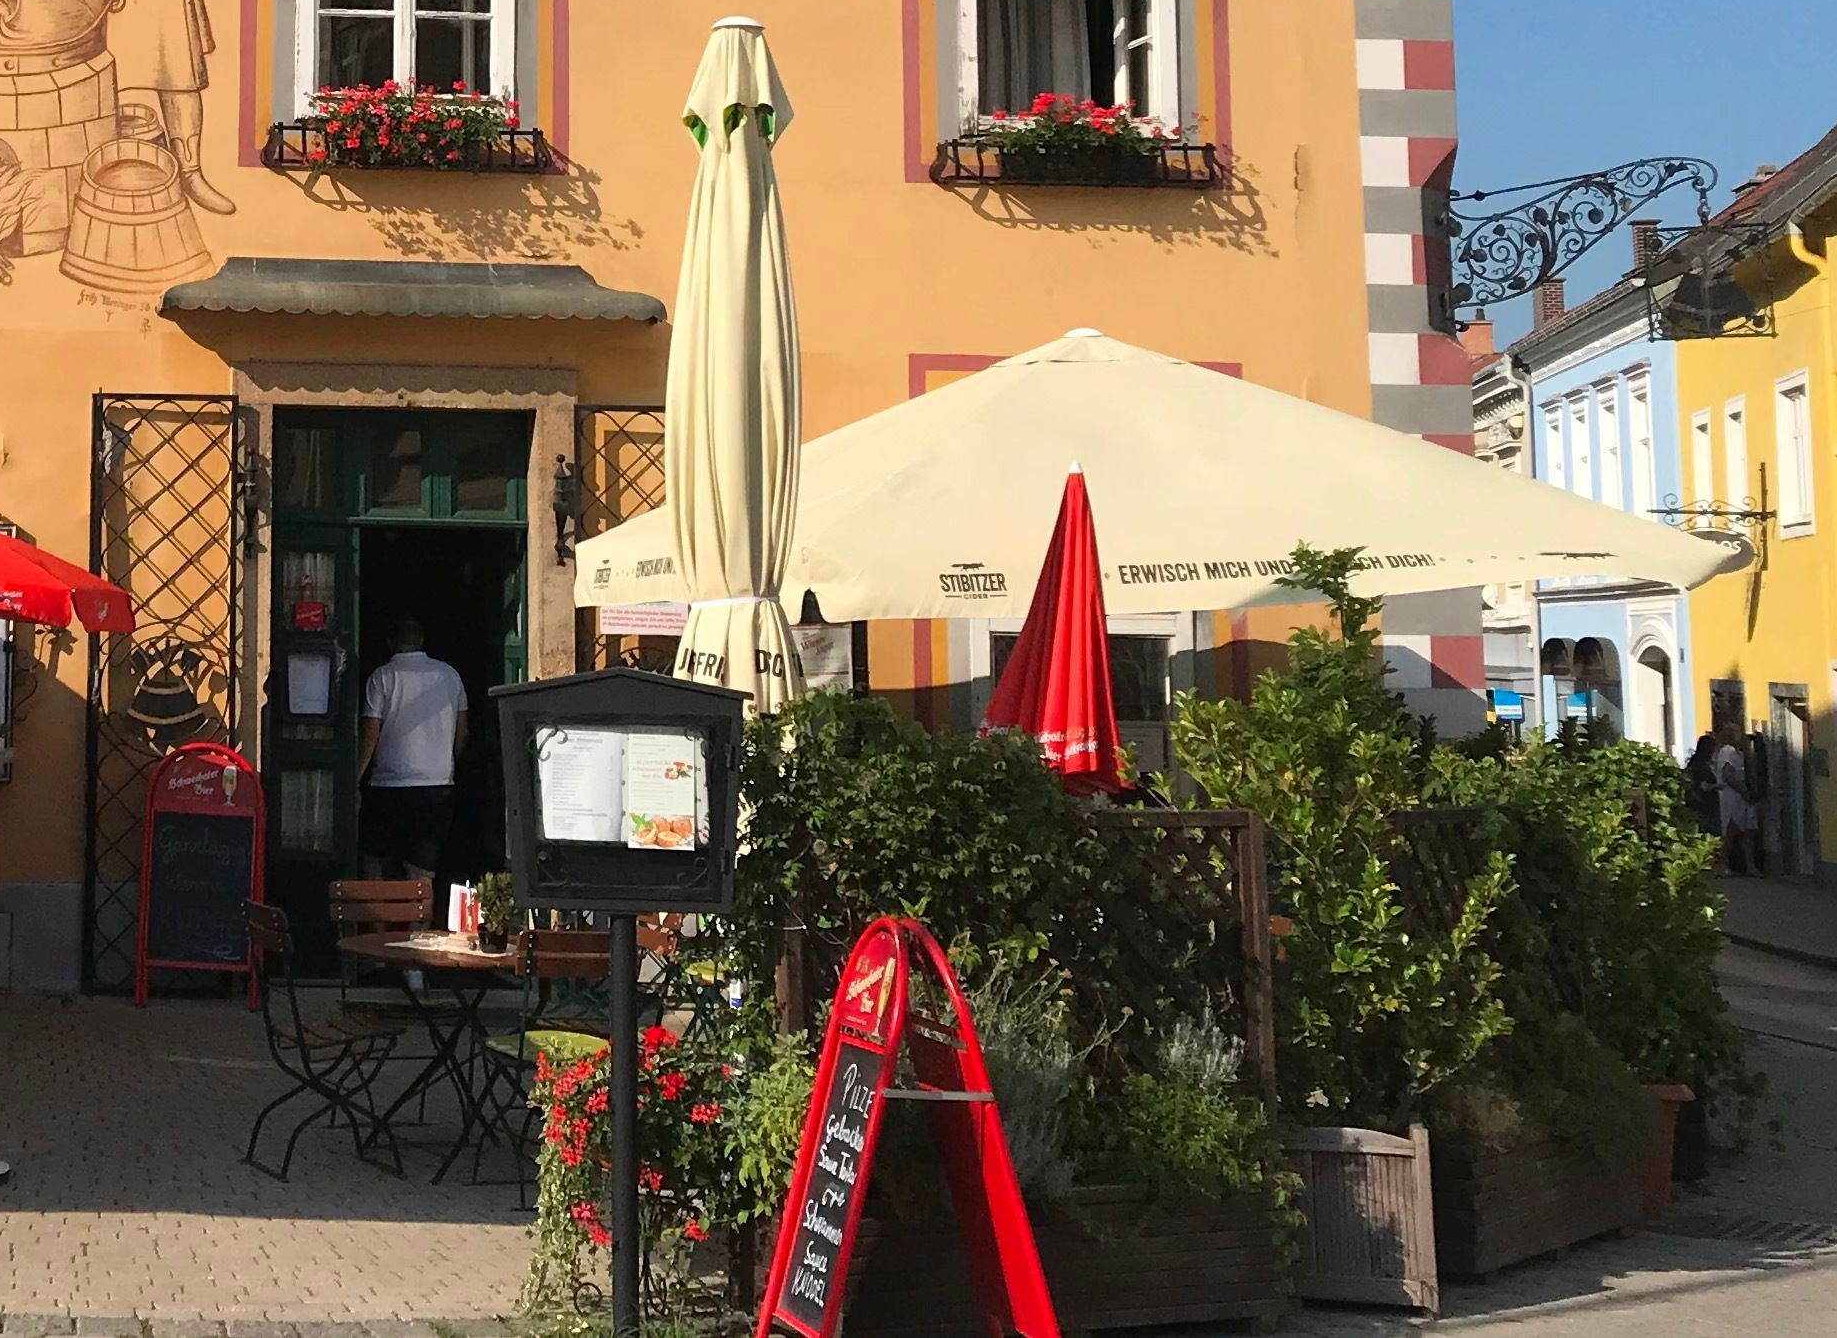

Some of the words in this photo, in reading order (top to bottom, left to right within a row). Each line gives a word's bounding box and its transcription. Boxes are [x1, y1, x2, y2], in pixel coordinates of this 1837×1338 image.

[1385, 553, 1437, 568] DICH!
[1118, 562, 1201, 585] ERWISCH
[1204, 560, 1252, 580] MICH
[1256, 559, 1292, 577] UND
[939, 573, 1008, 592] STIBITZER
